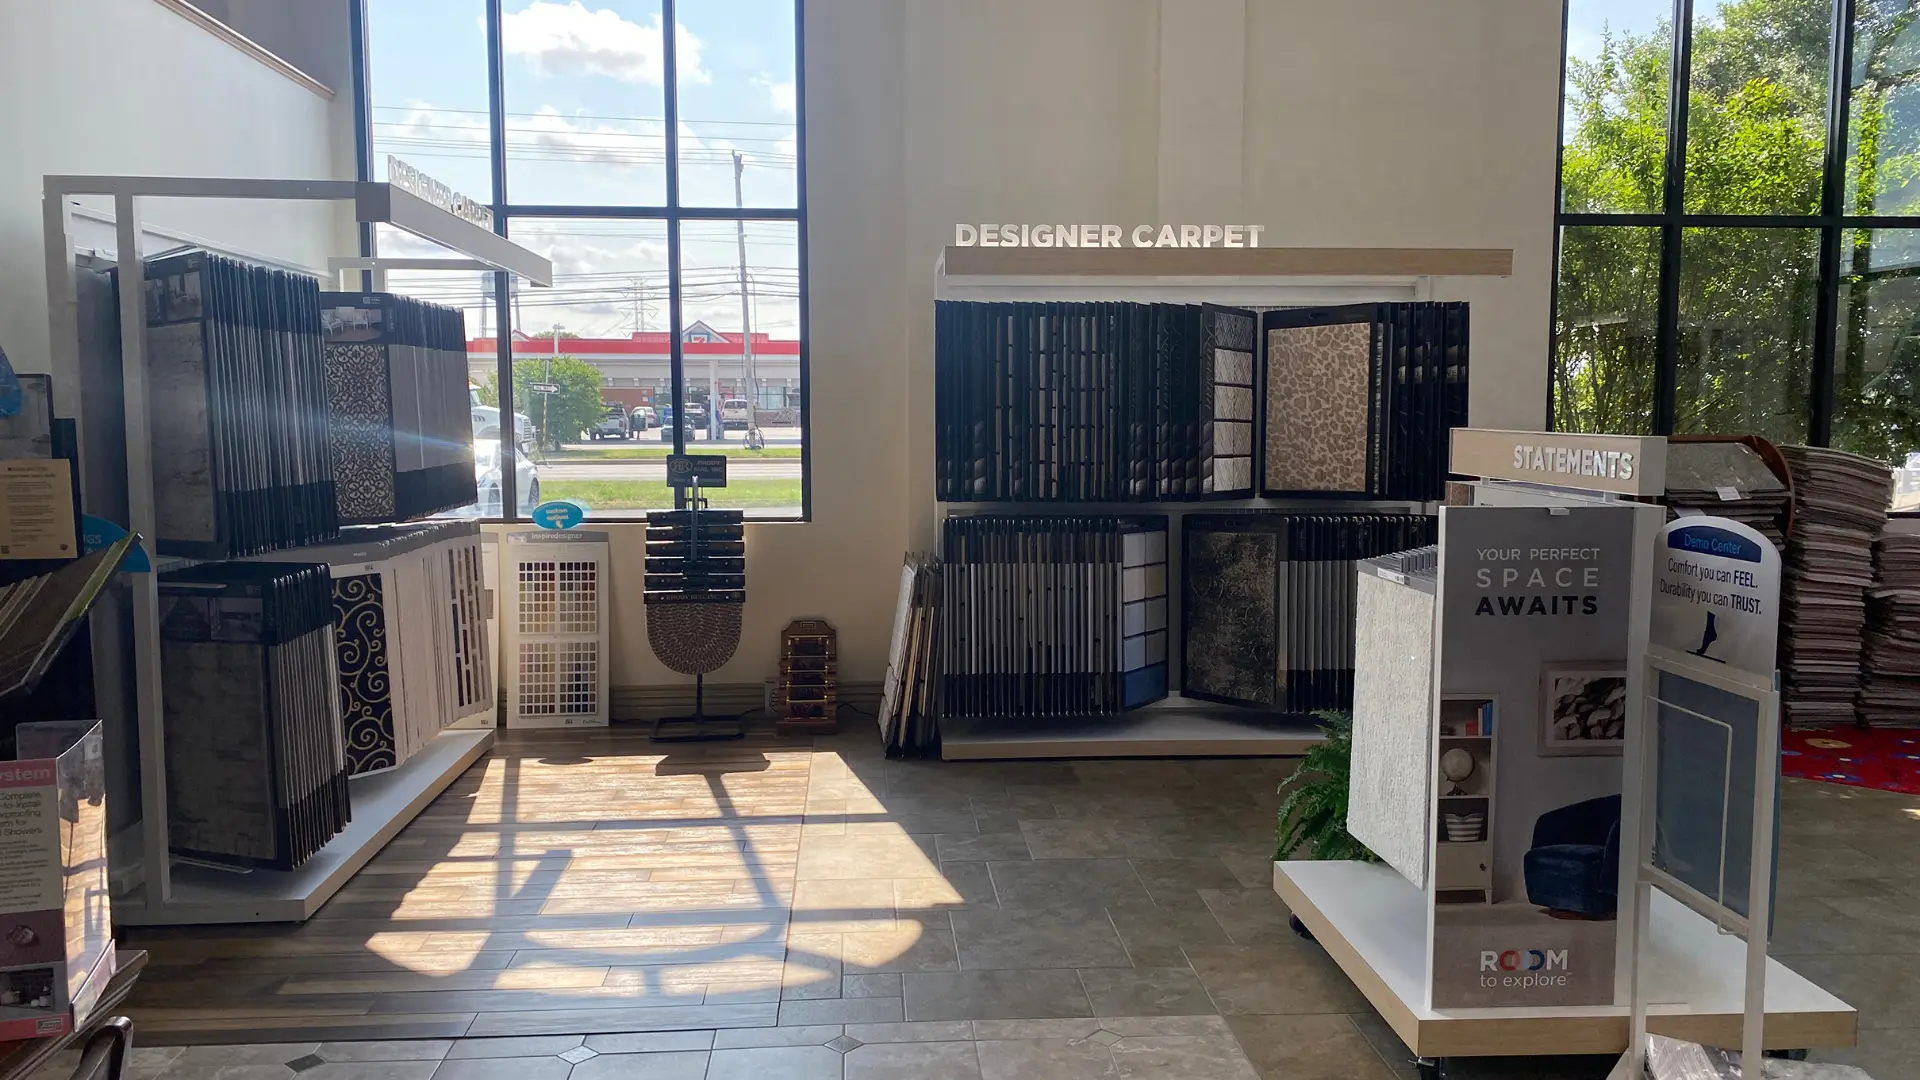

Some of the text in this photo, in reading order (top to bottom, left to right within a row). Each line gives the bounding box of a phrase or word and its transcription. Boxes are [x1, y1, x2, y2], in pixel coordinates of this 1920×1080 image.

[955, 223, 1265, 248] DESIGNER CARPET
[1513, 444, 1634, 481] STATEMENTS
[1476, 548, 1600, 561] YOUR PERFECT
[1684, 534, 1742, 555] Demo Center
[1476, 567, 1600, 588] SPACE
[1668, 557, 1759, 589] Comfort you can FEEL.
[1474, 595, 1599, 616] AWAITS
[1659, 579, 1762, 615] Durability you can TRUST.
[1480, 949, 1568, 972] ROOM
[1480, 973, 1567, 989] to explore
